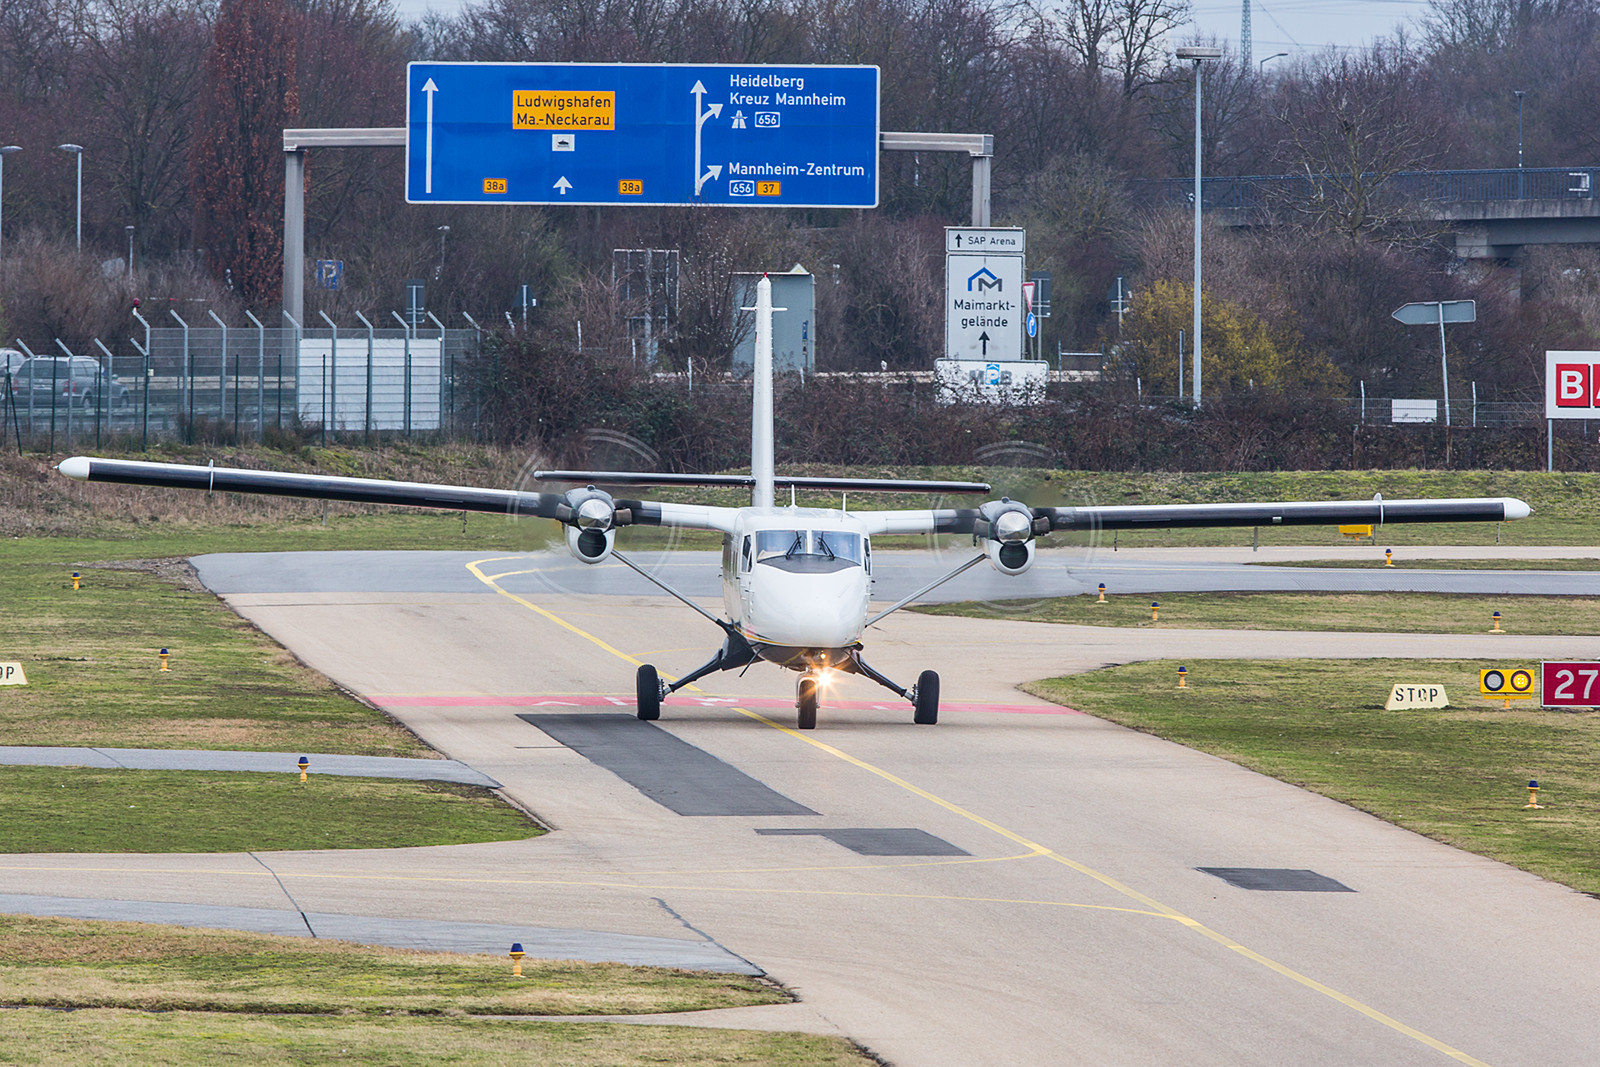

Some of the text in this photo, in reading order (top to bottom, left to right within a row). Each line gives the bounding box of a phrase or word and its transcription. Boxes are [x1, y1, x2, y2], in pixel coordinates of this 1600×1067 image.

[730, 74, 804, 90] Heidelberg
[517, 95, 611, 110] Ludwigshafen
[729, 92, 846, 106] Kreuz Mannheim
[516, 113, 610, 126] Ma.-Neckarau
[758, 114, 777, 125] 656
[729, 162, 865, 176] Mannheim-Zentrum
[486, 181, 505, 191] 38a
[622, 182, 641, 192] 38a
[732, 183, 775, 193] 656 37
[968, 236, 1016, 246] SAP Arena
[954, 299, 1016, 311] Maimarkt-
[961, 316, 1008, 329] gelände
[1560, 370, 1600, 400] B
[1554, 669, 1599, 699] 27
[1395, 687, 1438, 703] STOP
